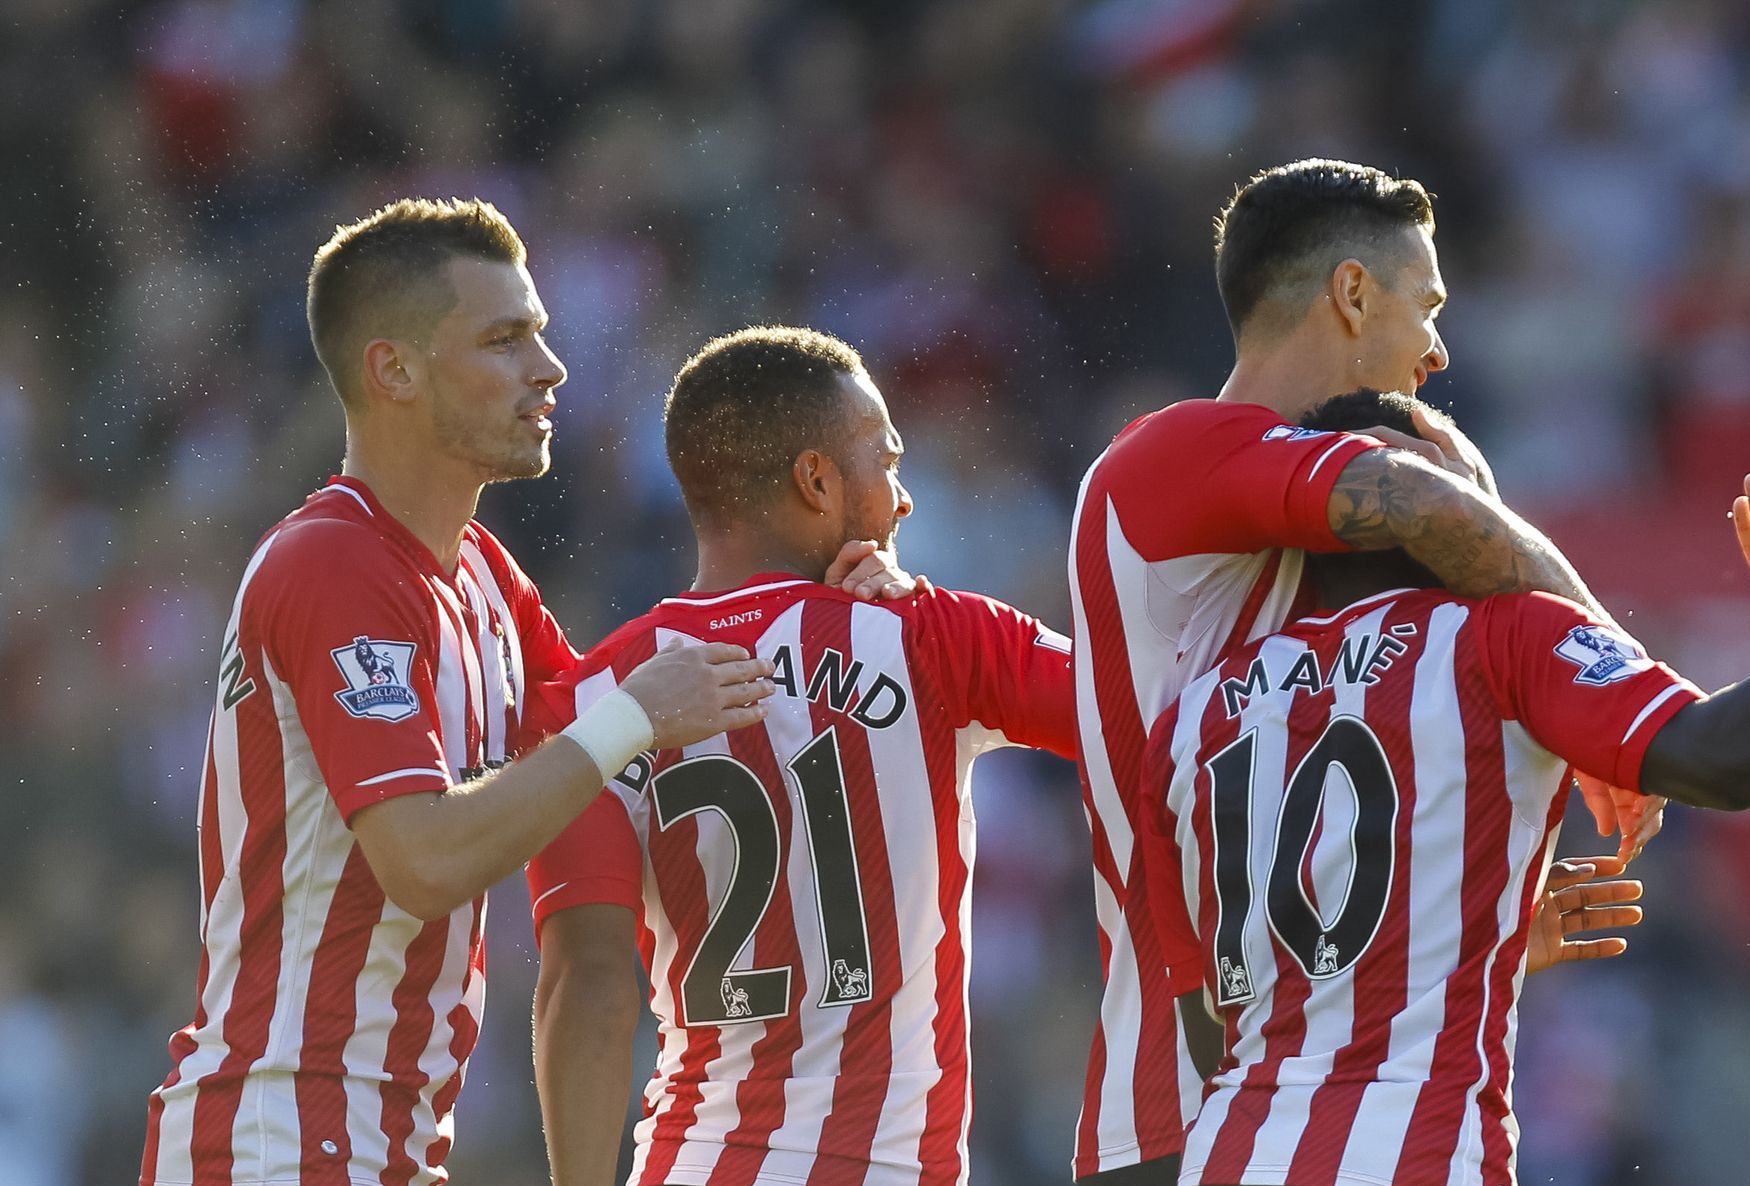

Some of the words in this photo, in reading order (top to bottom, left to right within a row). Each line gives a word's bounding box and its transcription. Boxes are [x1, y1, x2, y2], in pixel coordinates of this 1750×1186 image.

[709, 608, 763, 630] SAINTS
[1592, 656, 1618, 674] BARC
[356, 688, 405, 703] BARCLAYS
[1204, 714, 1399, 1005] 10
[651, 725, 872, 1026] 21
